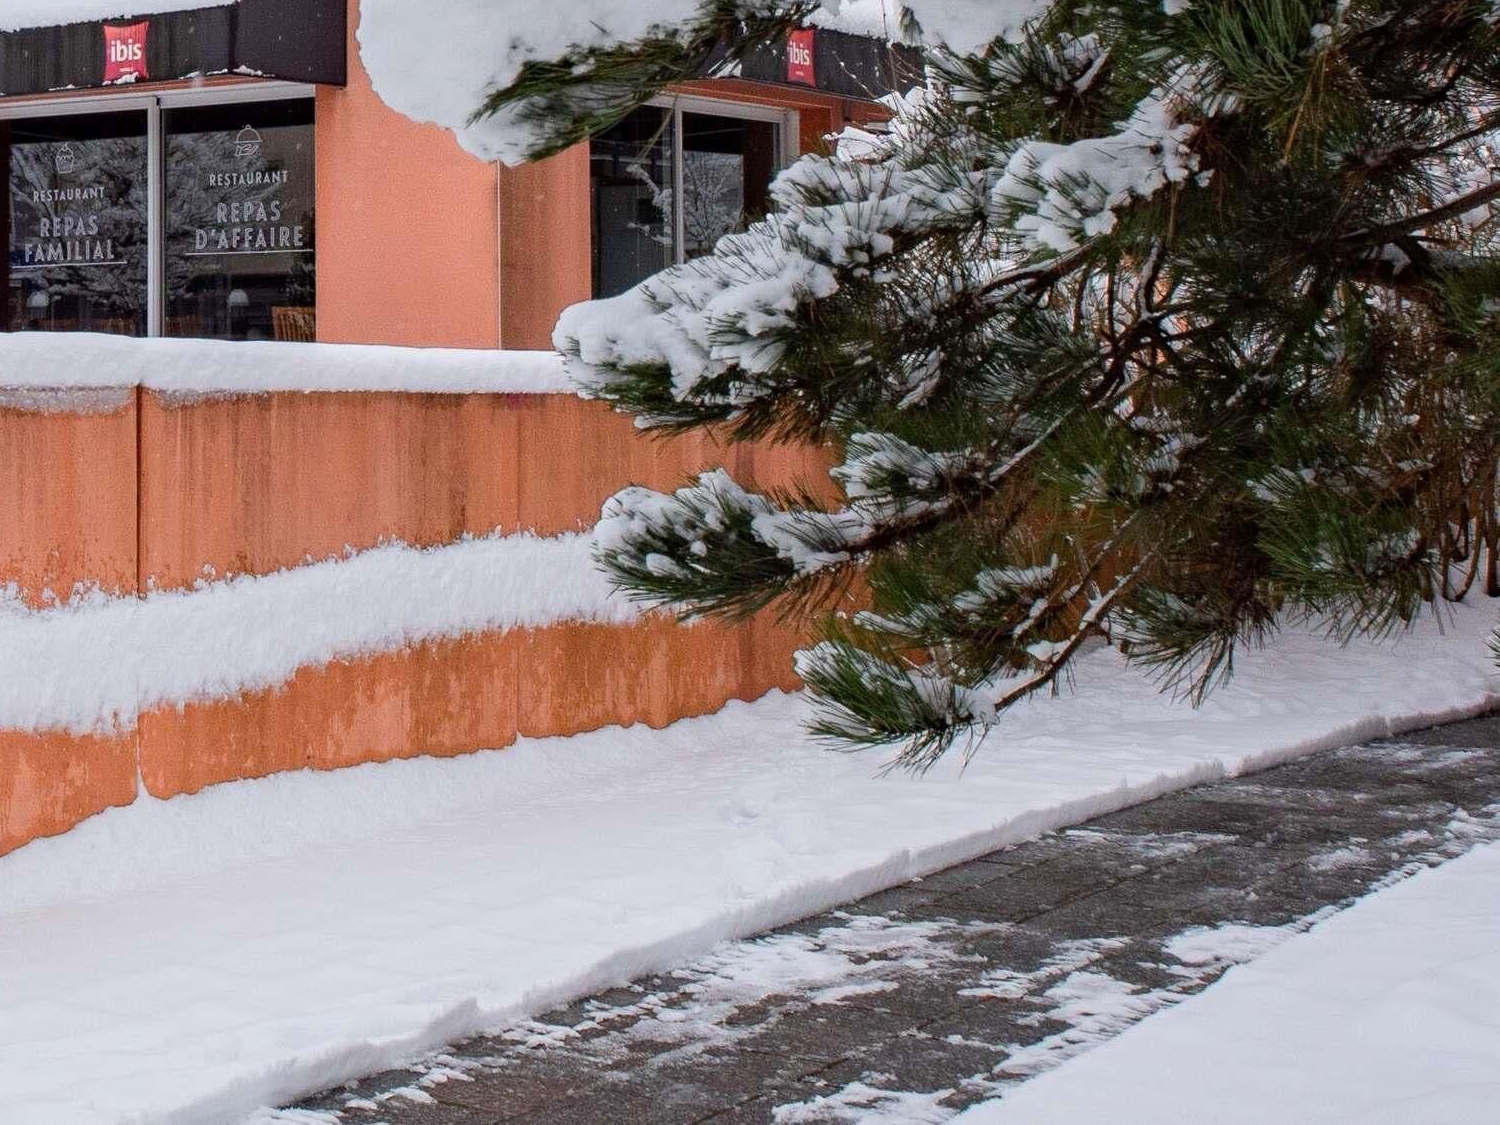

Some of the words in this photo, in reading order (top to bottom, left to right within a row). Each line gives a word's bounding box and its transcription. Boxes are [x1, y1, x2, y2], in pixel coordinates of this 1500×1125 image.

[110, 38, 142, 63] ibis
[788, 40, 810, 65] ibis
[209, 171, 289, 187] RESTAURANT
[33, 186, 105, 203] RESTAURANT
[216, 200, 281, 223] REPAS
[39, 215, 99, 237] REPAS
[195, 226, 304, 250] D'AFFAIRE
[24, 239, 115, 263] FAMILIAL
